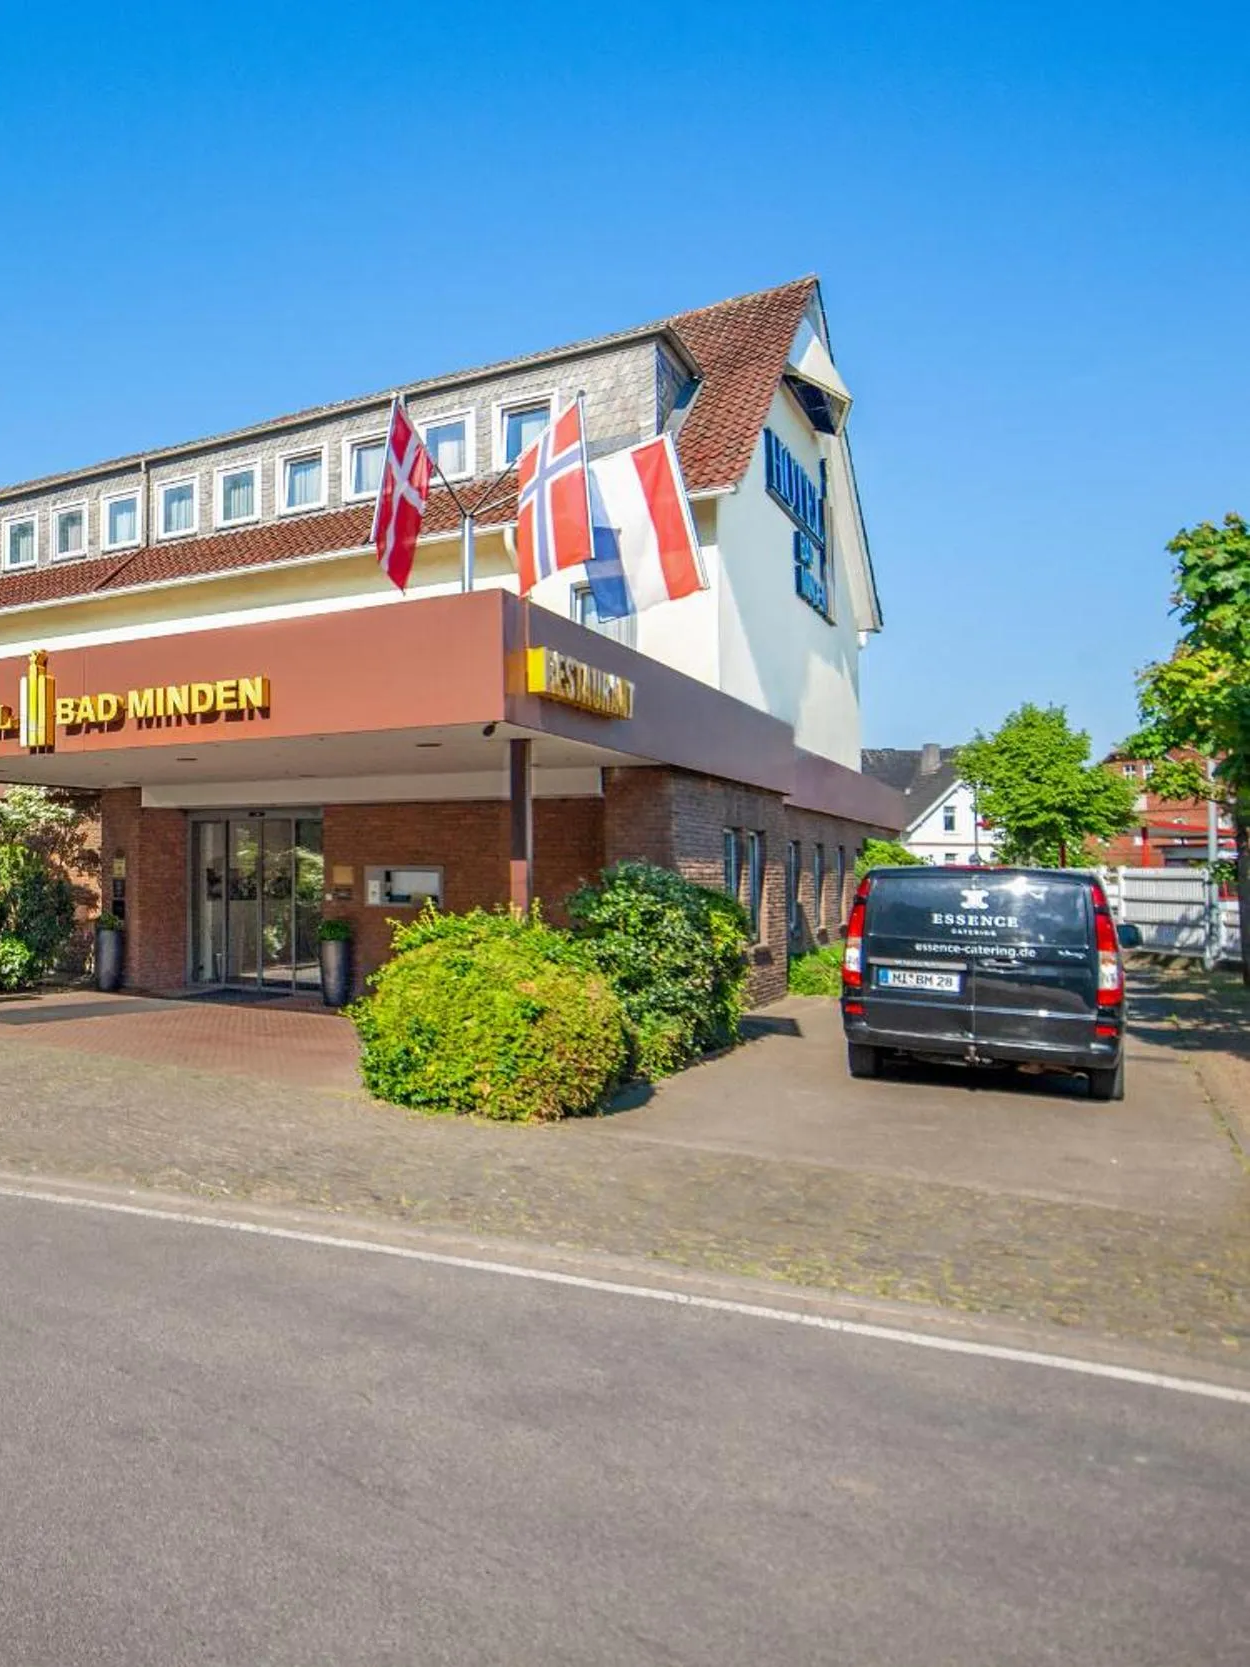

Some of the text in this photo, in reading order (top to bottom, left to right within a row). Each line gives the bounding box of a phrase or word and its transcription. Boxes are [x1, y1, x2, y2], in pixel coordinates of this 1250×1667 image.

[55, 691, 121, 727] BAD
[127, 675, 267, 720] MINDEN
[932, 912, 1019, 928] ESSENCE
[915, 941, 1037, 958] essence-catering.de
